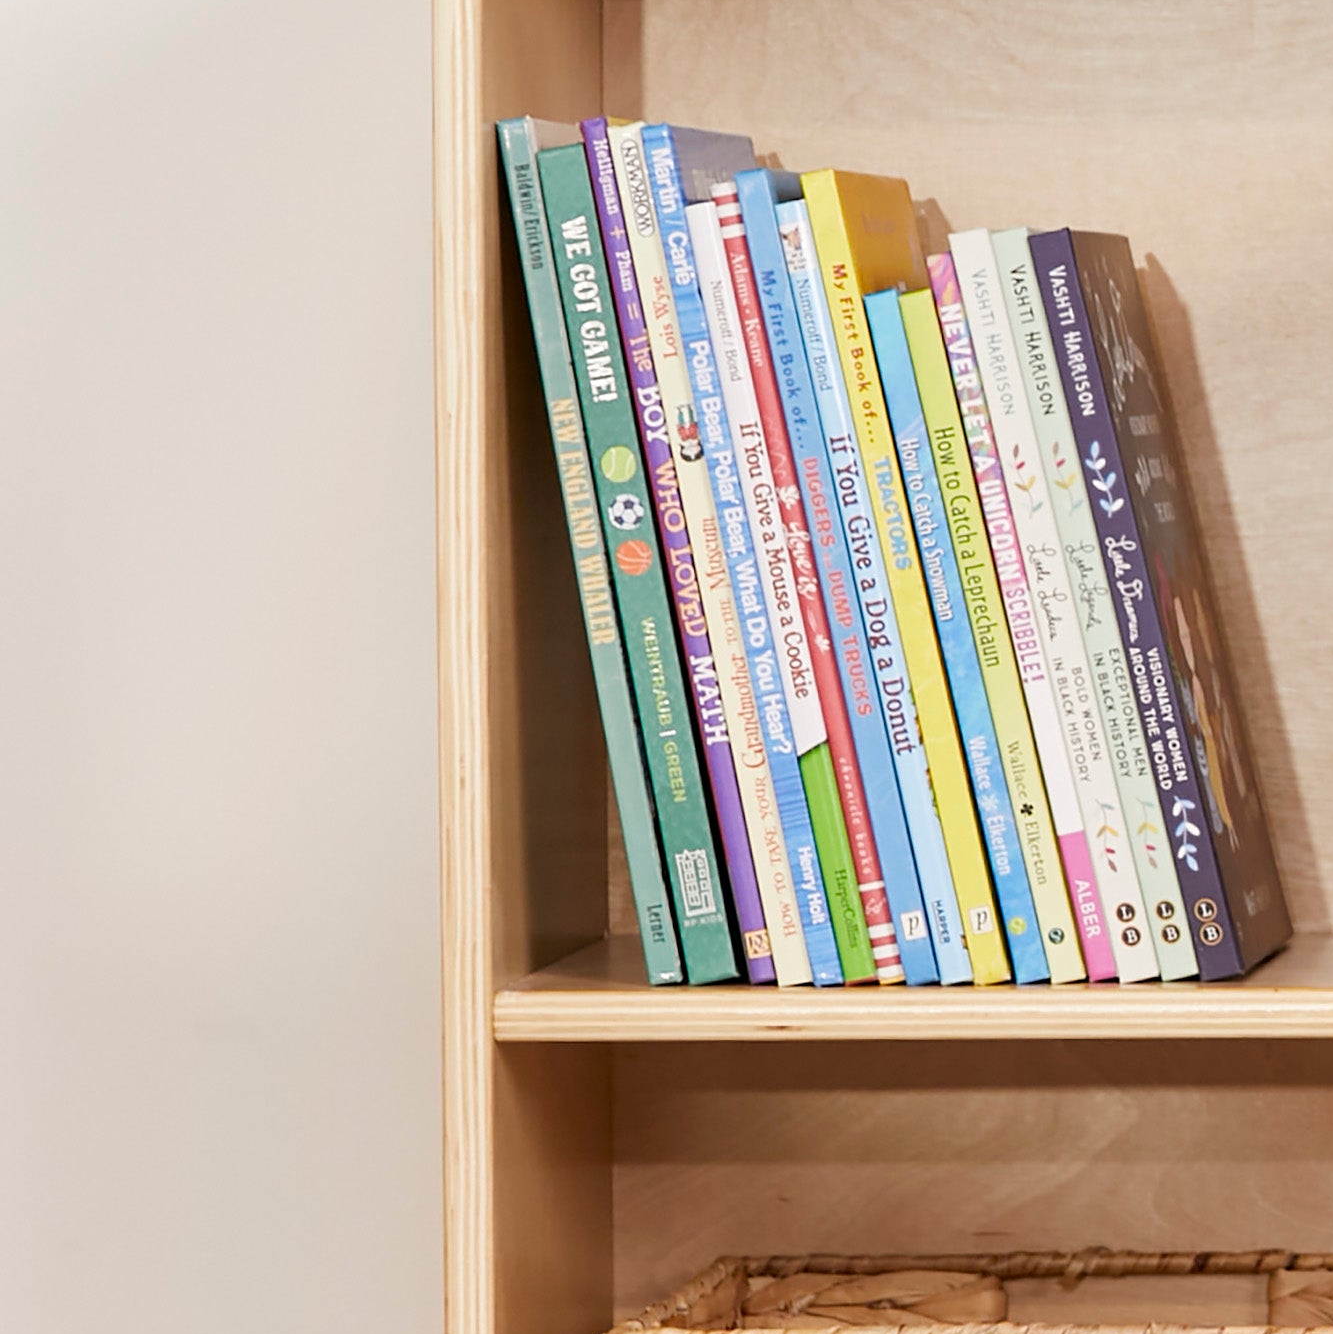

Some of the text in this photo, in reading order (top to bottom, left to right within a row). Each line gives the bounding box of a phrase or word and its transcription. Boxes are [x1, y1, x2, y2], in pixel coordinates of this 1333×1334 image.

[524, 218, 543, 270] Erickson
[623, 144, 653, 231] WORKMAN
[651, 147, 692, 286] Martin Carle
[561, 215, 618, 404] WE GOT GAME!
[653, 276, 678, 359] Lois Wyse
[710, 279, 742, 383] Numeroff Bond
[729, 252, 764, 367] Adams Keane
[760, 269, 800, 398] My First Book
[797, 279, 833, 392] Numeroff Bond
[832, 264, 872, 392] My First Book
[971, 267, 1015, 416] VASHTI HARRISON
[1010, 264, 1056, 417] VASHTI HARRISON
[1048, 264, 1097, 418] VASHTI HARRISON
[593, 138, 729, 745] Heiligman Pham The BOY WHO LOVED MATH
[940, 303, 1044, 684] NEVER LET A UNICORN SCRIBBLE!
[551, 398, 615, 646] NEW ENGLAND WHALER
[688, 339, 793, 755] Polar Bear, Polar Bear, What Do You Hear?
[740, 422, 809, 699] If You Give a Mouse a Cookie
[873, 455, 912, 572] TRACTORS
[899, 437, 953, 623] How to Catch Snowman
[933, 426, 1000, 668] How to Catch Leprechaun
[802, 457, 873, 716] DIGGERS DUMP TRUCKS
[830, 434, 916, 756] If You Give a Dog a Donut
[640, 616, 688, 804] WEINTRAUB GREEN
[703, 516, 797, 938] HOW TO TAKE YOUR Grandmother Museum
[1052, 656, 1091, 784] IN BLACK HISTORY
[1071, 666, 1103, 762] BOLD WOMEN
[1093, 652, 1132, 779] IN BLACK HISTORY
[1108, 647, 1148, 778] EXCEPTIONAL MEN
[1128, 647, 1173, 791] AROUND THE WORLD
[1146, 646, 1189, 783] VISIONARY WOMEN
[856, 833, 872, 875] books
[968, 736, 1011, 877] Wallace Elkerton
[1006, 740, 1048, 887] Wallace Elkerton
[647, 903, 666, 944] Lerner
[797, 845, 826, 925] Henry Holt
[934, 899, 951, 944] HARPER
[1074, 879, 1102, 940] ALBER
